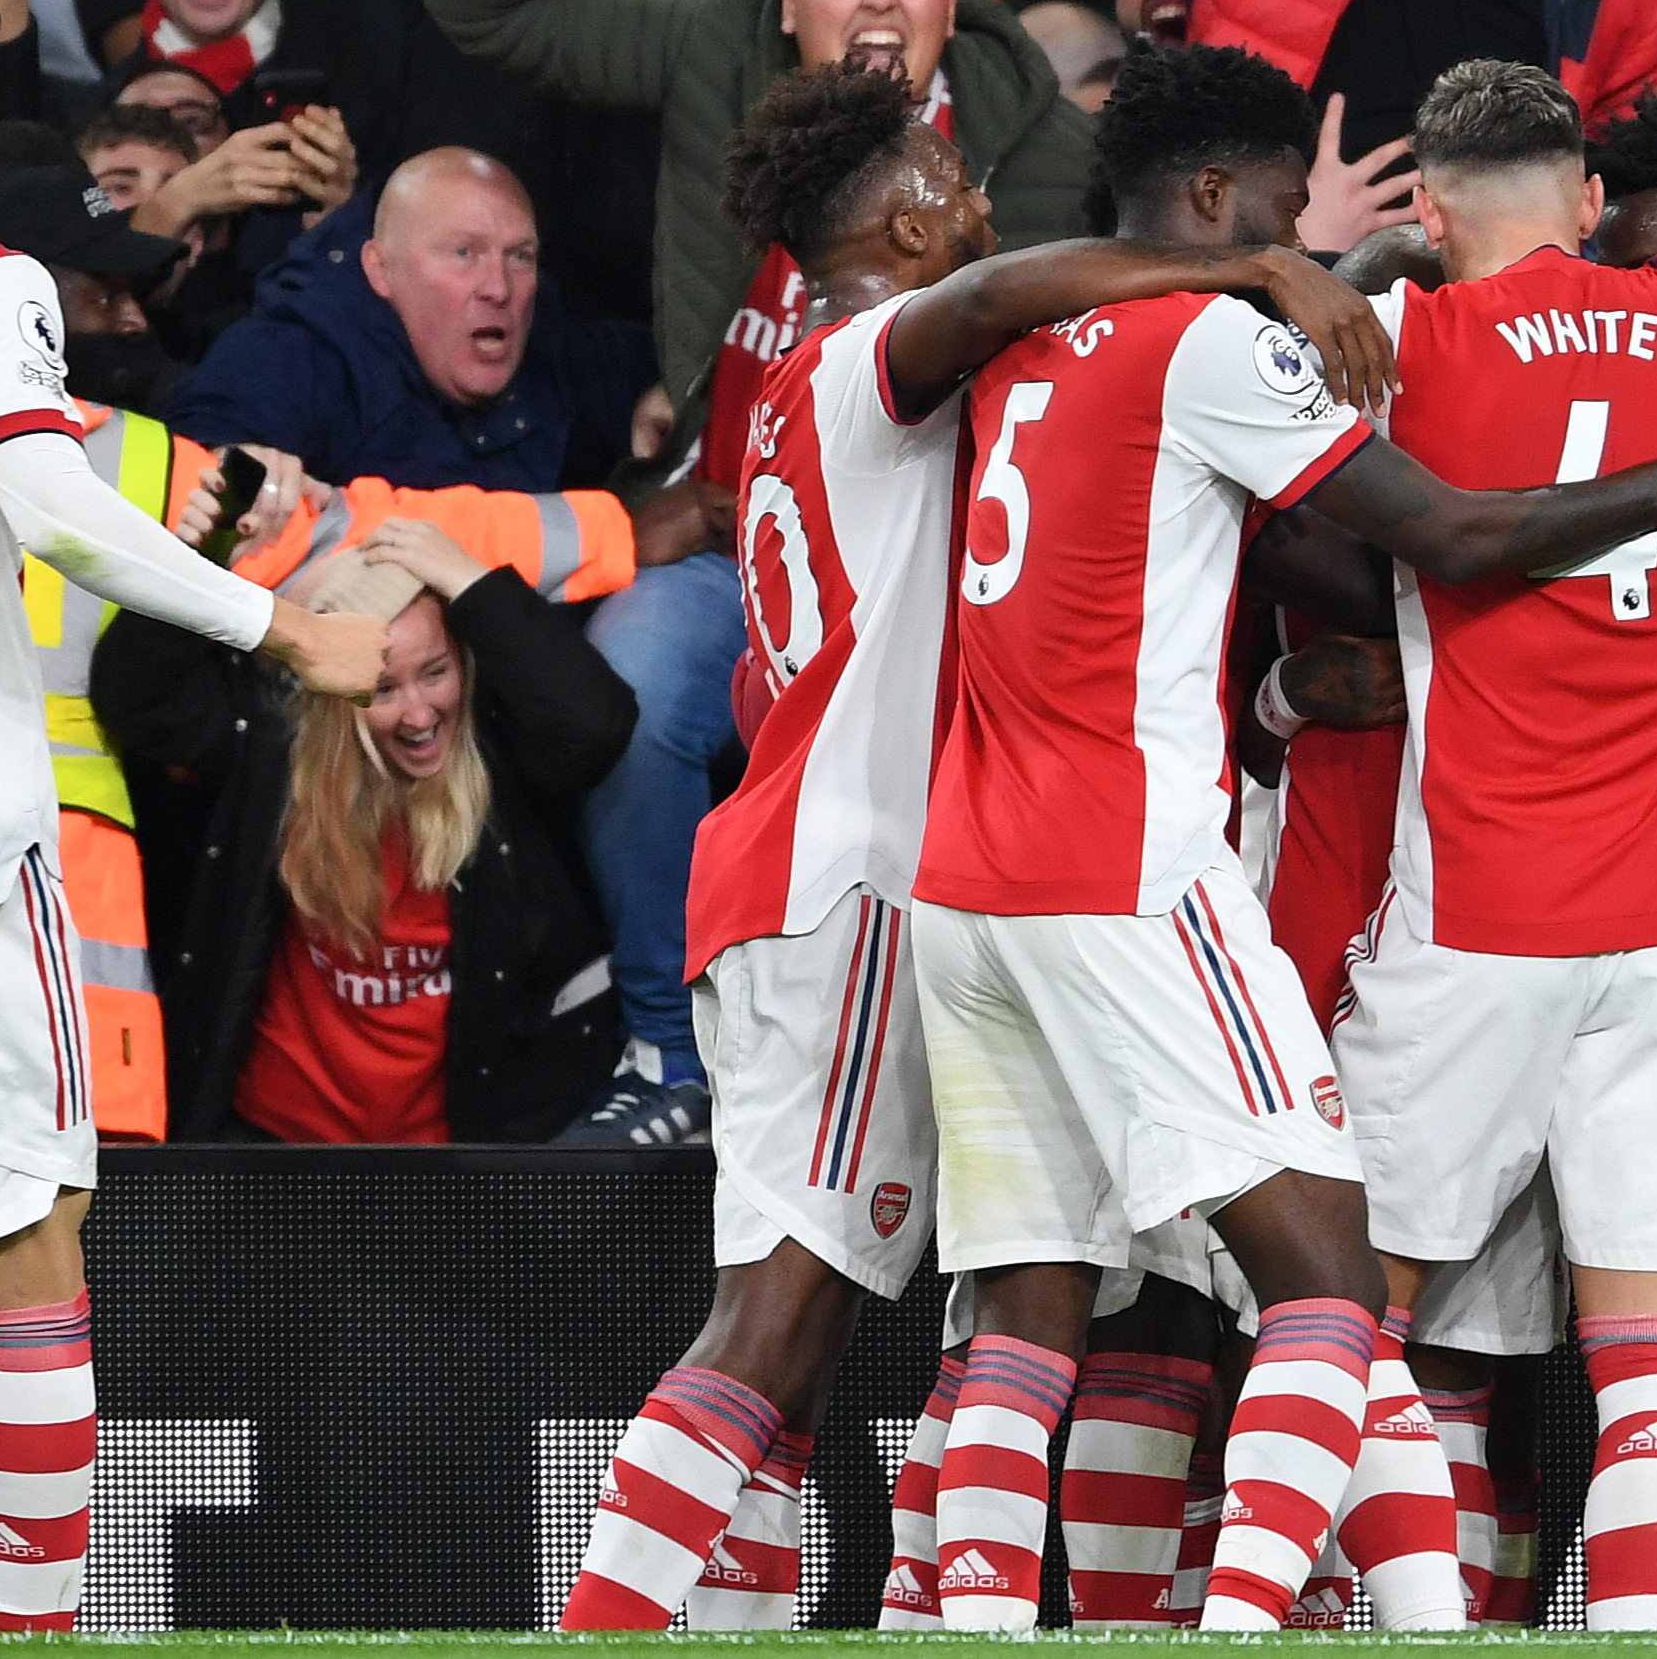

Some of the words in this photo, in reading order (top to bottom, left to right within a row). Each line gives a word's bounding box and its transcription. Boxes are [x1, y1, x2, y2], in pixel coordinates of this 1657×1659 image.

[961, 380, 1055, 606] 5
[737, 472, 824, 700] 0
[1373, 1422, 1435, 1434] adid
[937, 1573, 1010, 1590] adidas
